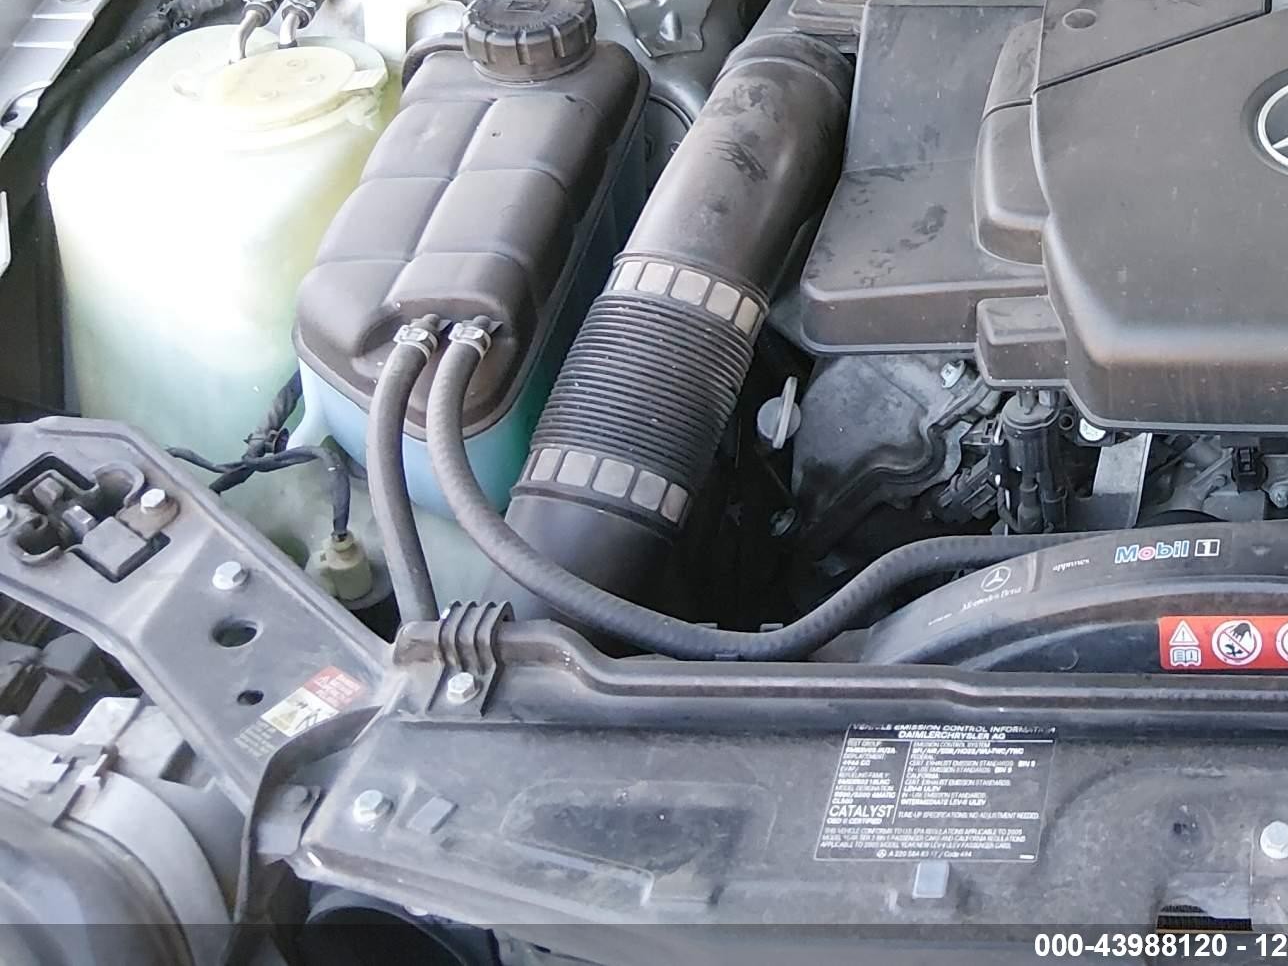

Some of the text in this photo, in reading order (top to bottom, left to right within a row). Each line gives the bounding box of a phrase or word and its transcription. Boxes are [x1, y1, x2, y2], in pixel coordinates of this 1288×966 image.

[1114, 540, 1190, 564] Mobil
[898, 731, 990, 740] DAIMLERCHRYSLER
[829, 805, 895, 818] CATALYST
